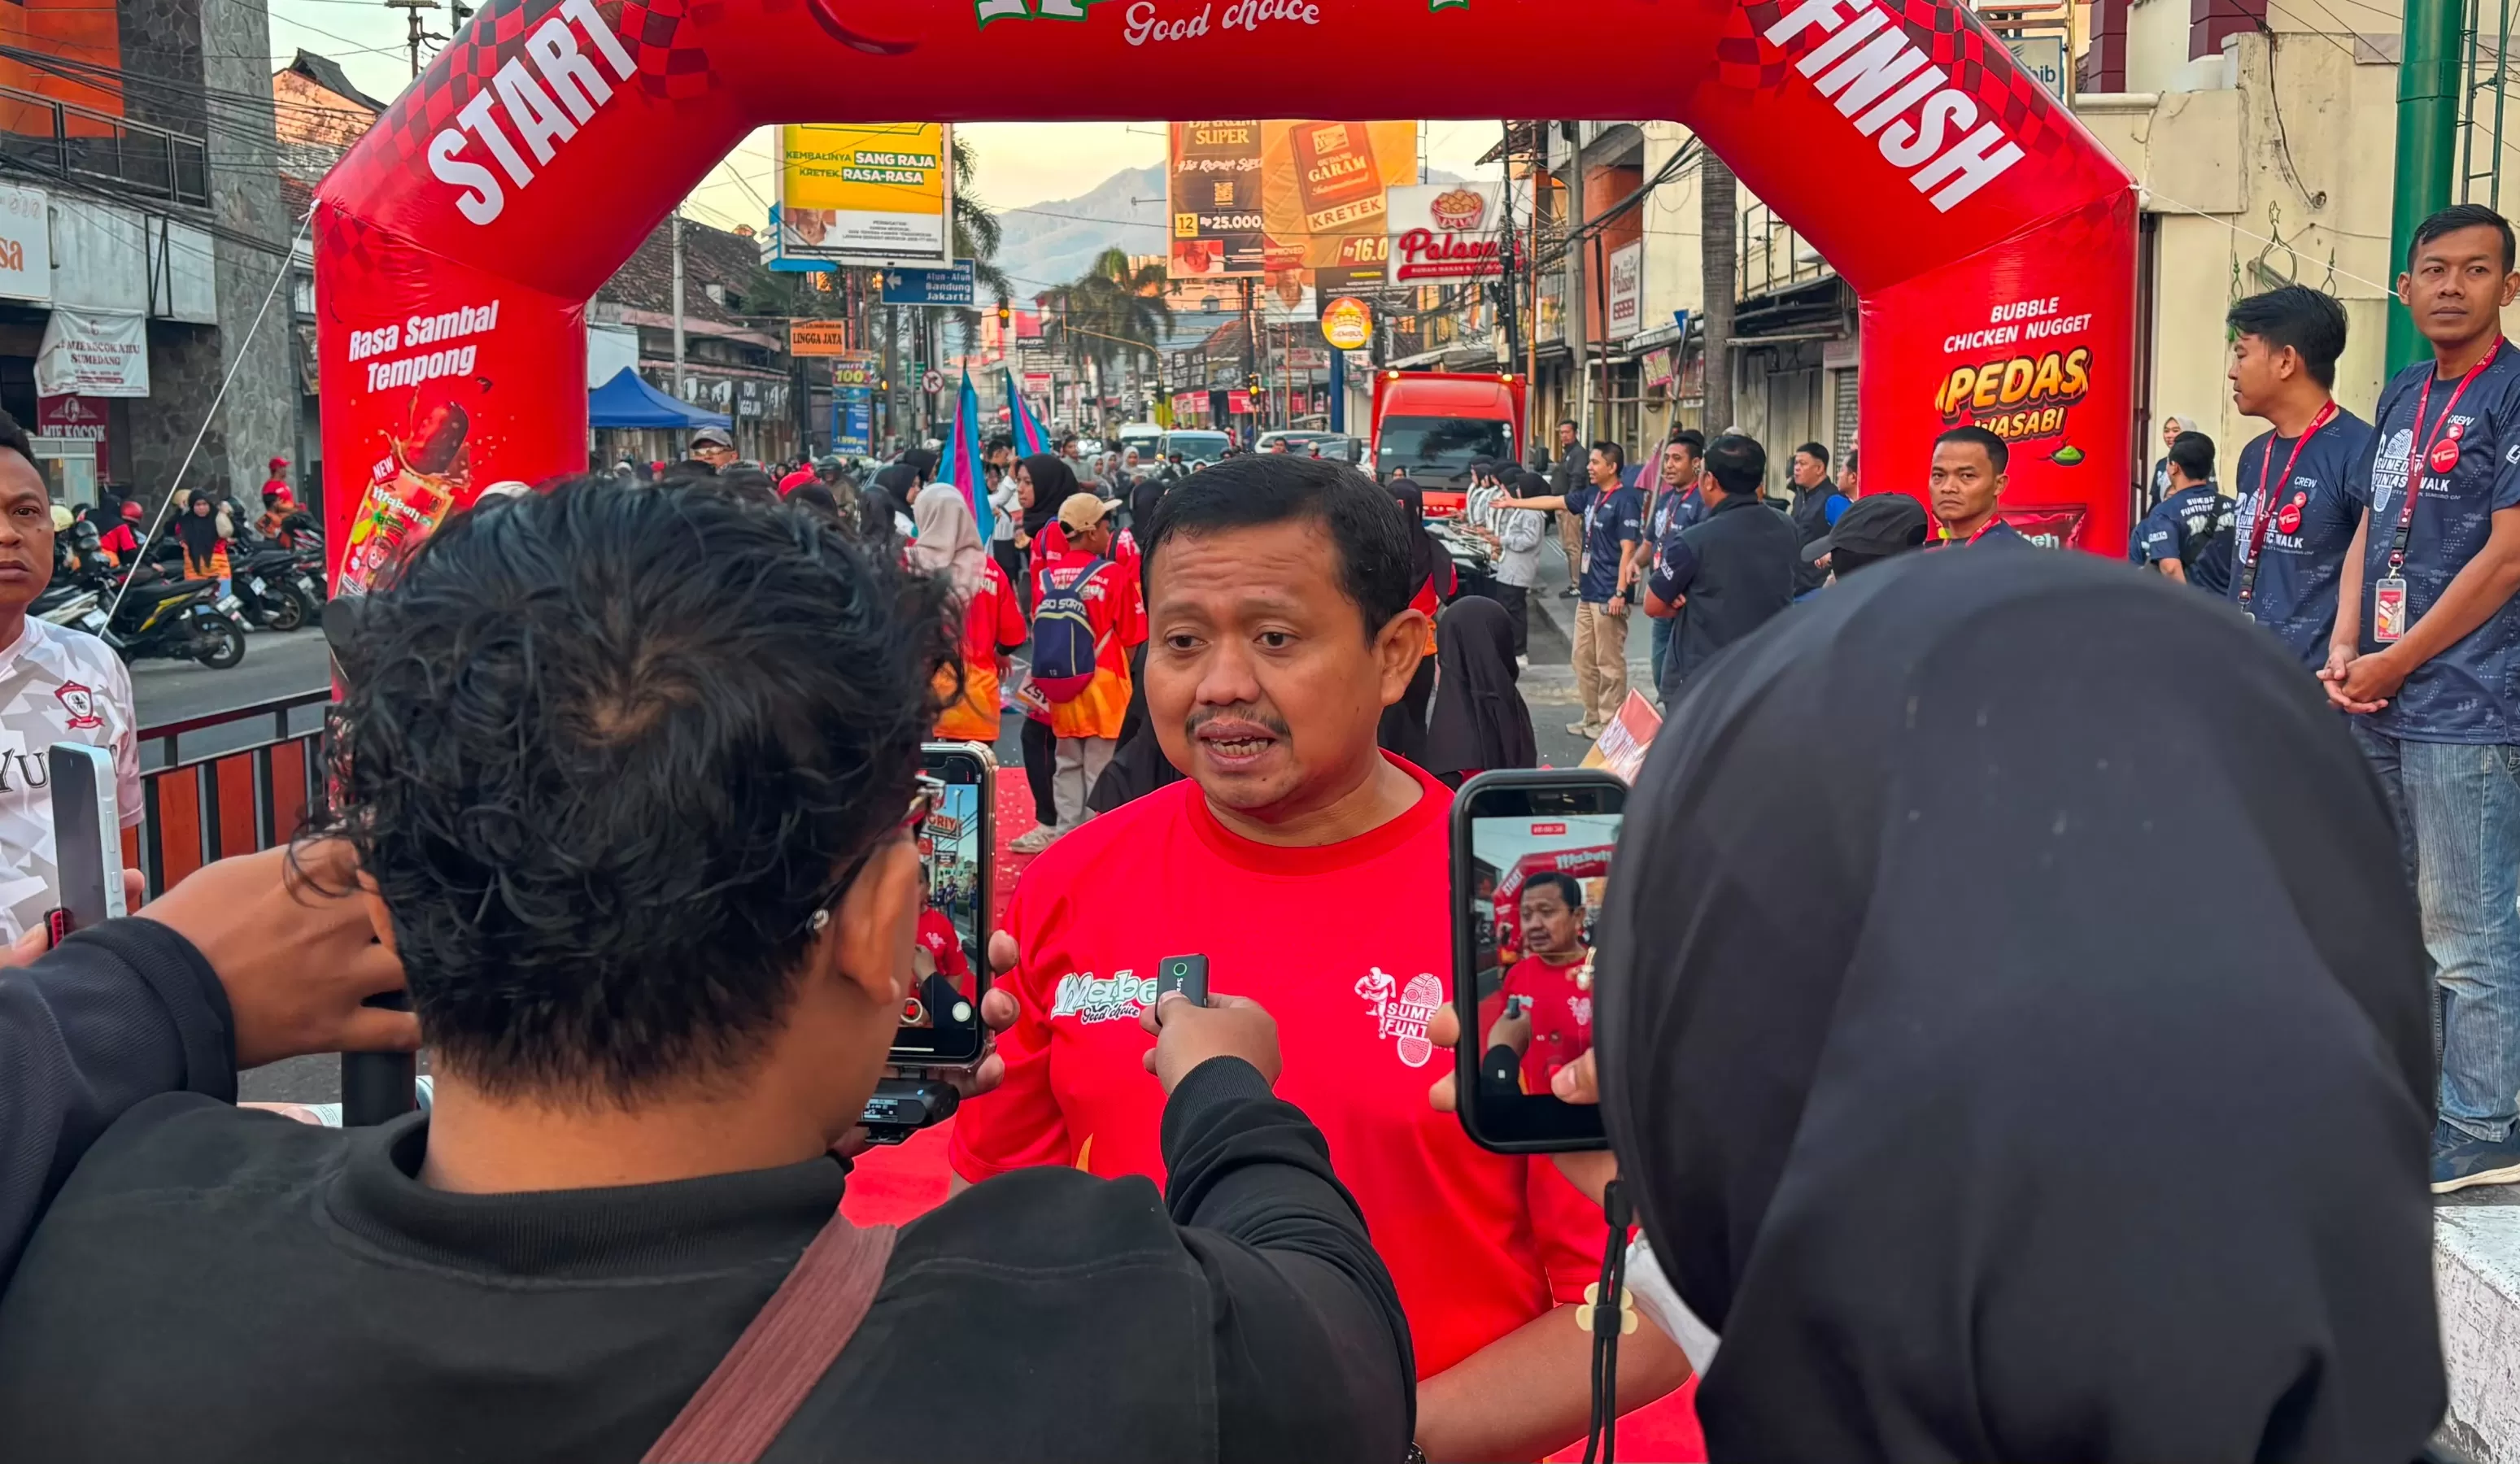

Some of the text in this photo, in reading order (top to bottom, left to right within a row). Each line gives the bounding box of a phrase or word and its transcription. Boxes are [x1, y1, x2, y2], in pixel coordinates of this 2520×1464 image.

[1123, 2, 1211, 46] Good
[1222, 0, 1320, 31] choice
[428, 0, 638, 225] START
[1764, 0, 2025, 214] FINISH
[1196, 129, 1249, 145] SUPER
[786, 150, 935, 168] KEMBALINYA SANG RAJA
[1308, 156, 1367, 182] GARAM
[800, 168, 924, 183] KRETEK RASA-RASA
[1179, 217, 1193, 229] 12
[1311, 198, 1381, 229] KRETEK
[926, 282, 970, 293] Bandung
[926, 293, 970, 301] Jakarta
[1990, 296, 2059, 323] BUBBLE
[348, 324, 399, 362] Rasa
[404, 299, 499, 346] Sambal
[793, 332, 843, 345] LINGGA JAYA
[1943, 314, 2092, 353] CHICKEN NUGGET
[367, 345, 477, 393] Tempong
[1942, 346, 2091, 418] PEDAS
[64, 425, 105, 442] KOCOK
[373, 455, 395, 481] NEW
[2294, 476, 2317, 488] CREW
[2275, 534, 2304, 549] WALK
[1052, 969, 1158, 1020] Mabe
[1082, 1004, 1140, 1023] Good choice
